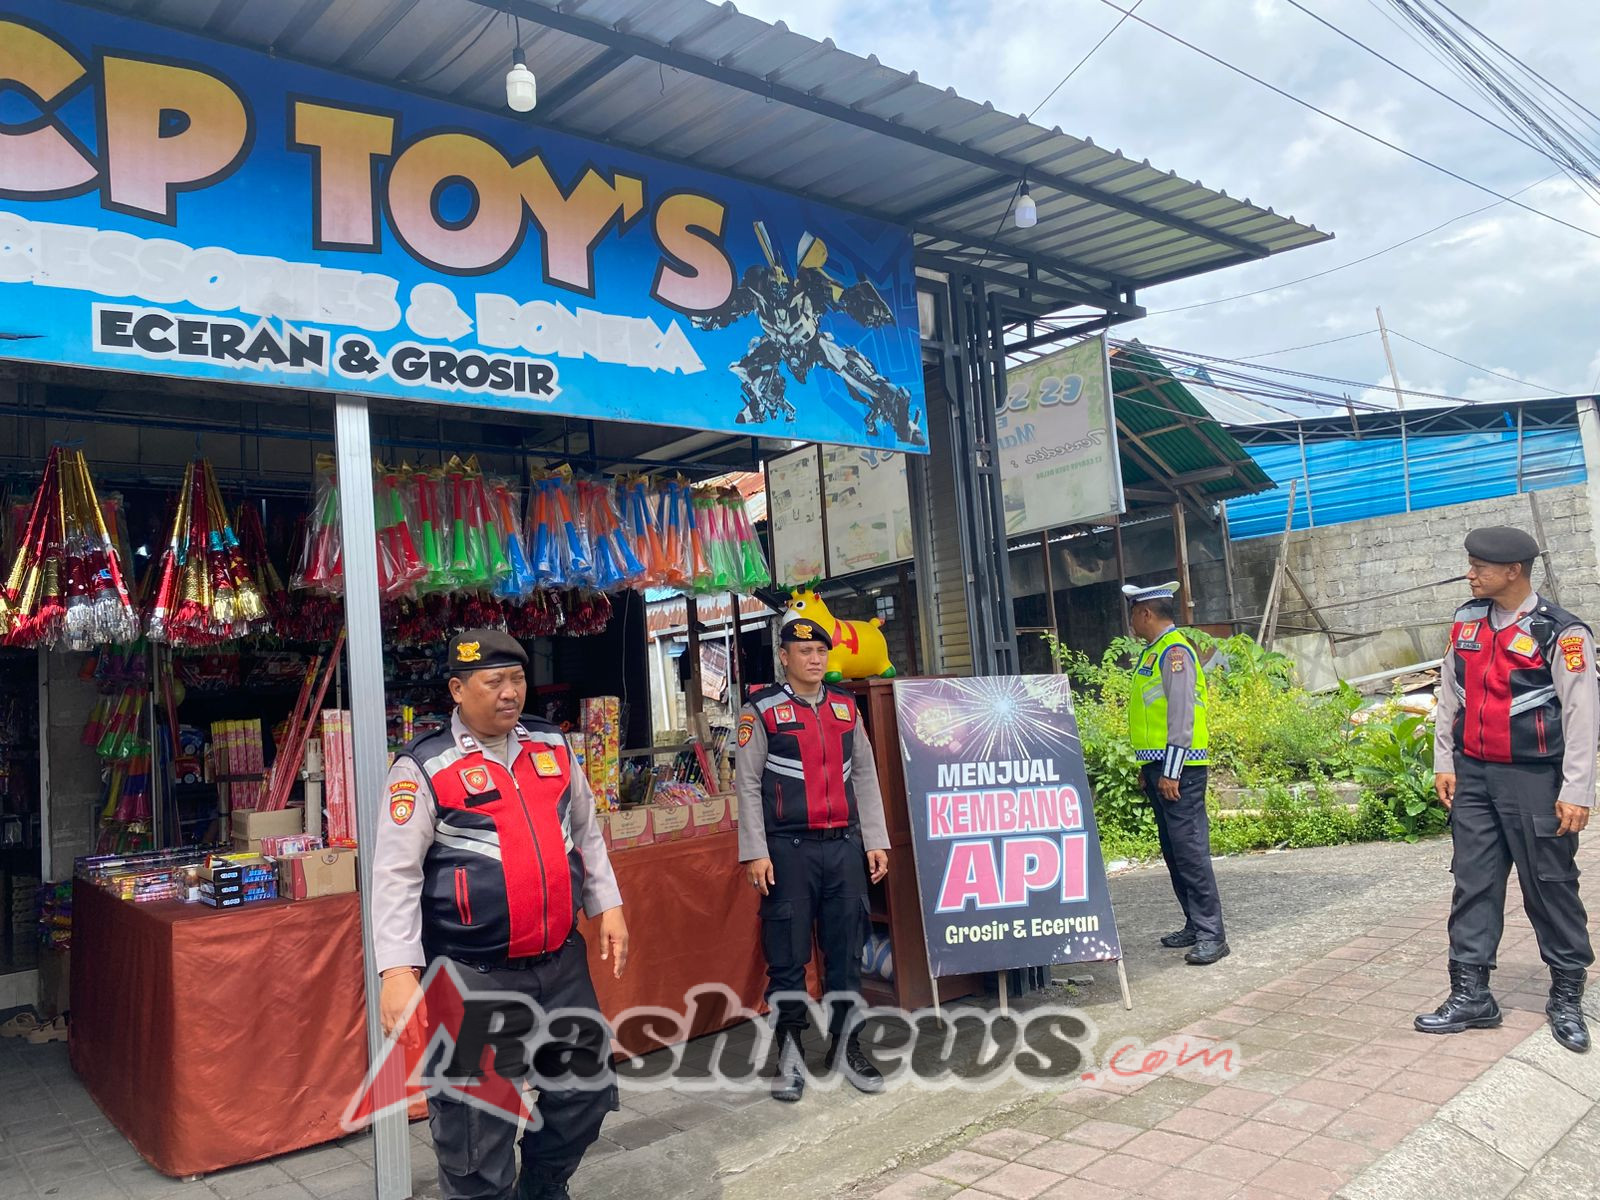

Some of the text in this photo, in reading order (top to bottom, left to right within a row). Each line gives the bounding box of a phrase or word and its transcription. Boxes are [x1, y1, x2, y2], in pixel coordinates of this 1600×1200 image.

[286, 93, 736, 315] TOY'S
[98, 308, 556, 397] ECERAN & GROSIR
[406, 283, 474, 341] &
[476, 293, 706, 374] BONEKA
[926, 784, 1084, 840] KEMBANG
[937, 758, 1060, 788] MENJUAL
[935, 831, 1088, 914] API
[945, 914, 1099, 945] Grosir & Eceran
